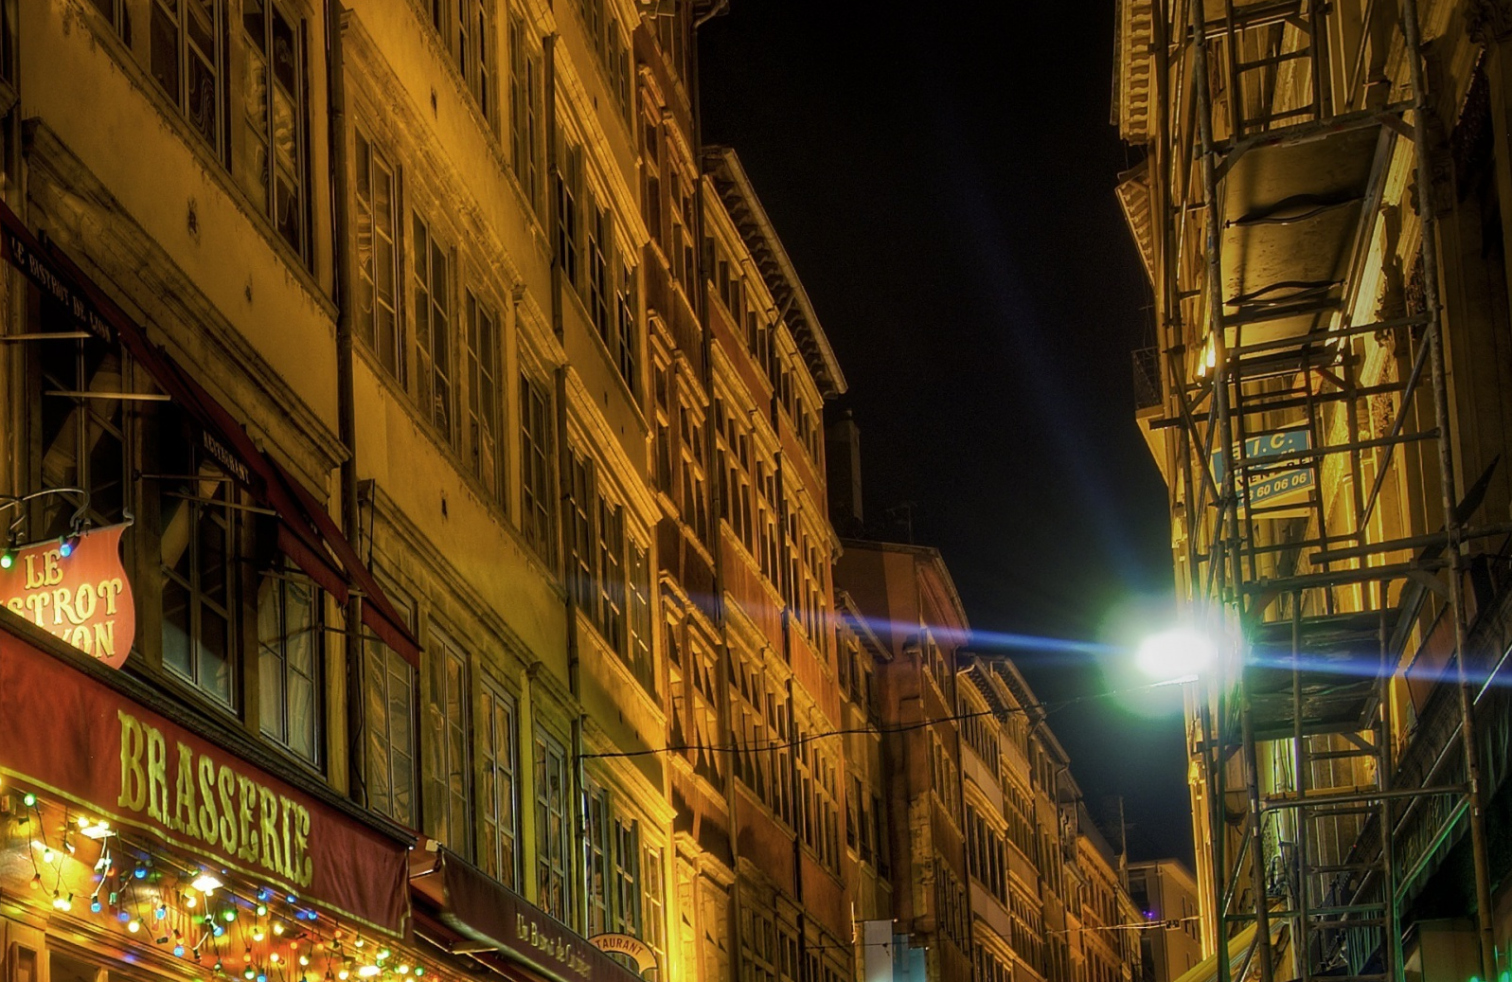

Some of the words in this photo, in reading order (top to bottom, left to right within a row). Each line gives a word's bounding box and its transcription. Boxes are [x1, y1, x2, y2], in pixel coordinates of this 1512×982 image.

[1256, 484, 1271, 498] 60
[1274, 478, 1289, 493] 06
[1291, 472, 1307, 487] 06
[24, 550, 64, 590] LE
[0, 577, 123, 628] STROT
[117, 710, 314, 887] BRASSERIE
[595, 938, 644, 956] TAURANT
